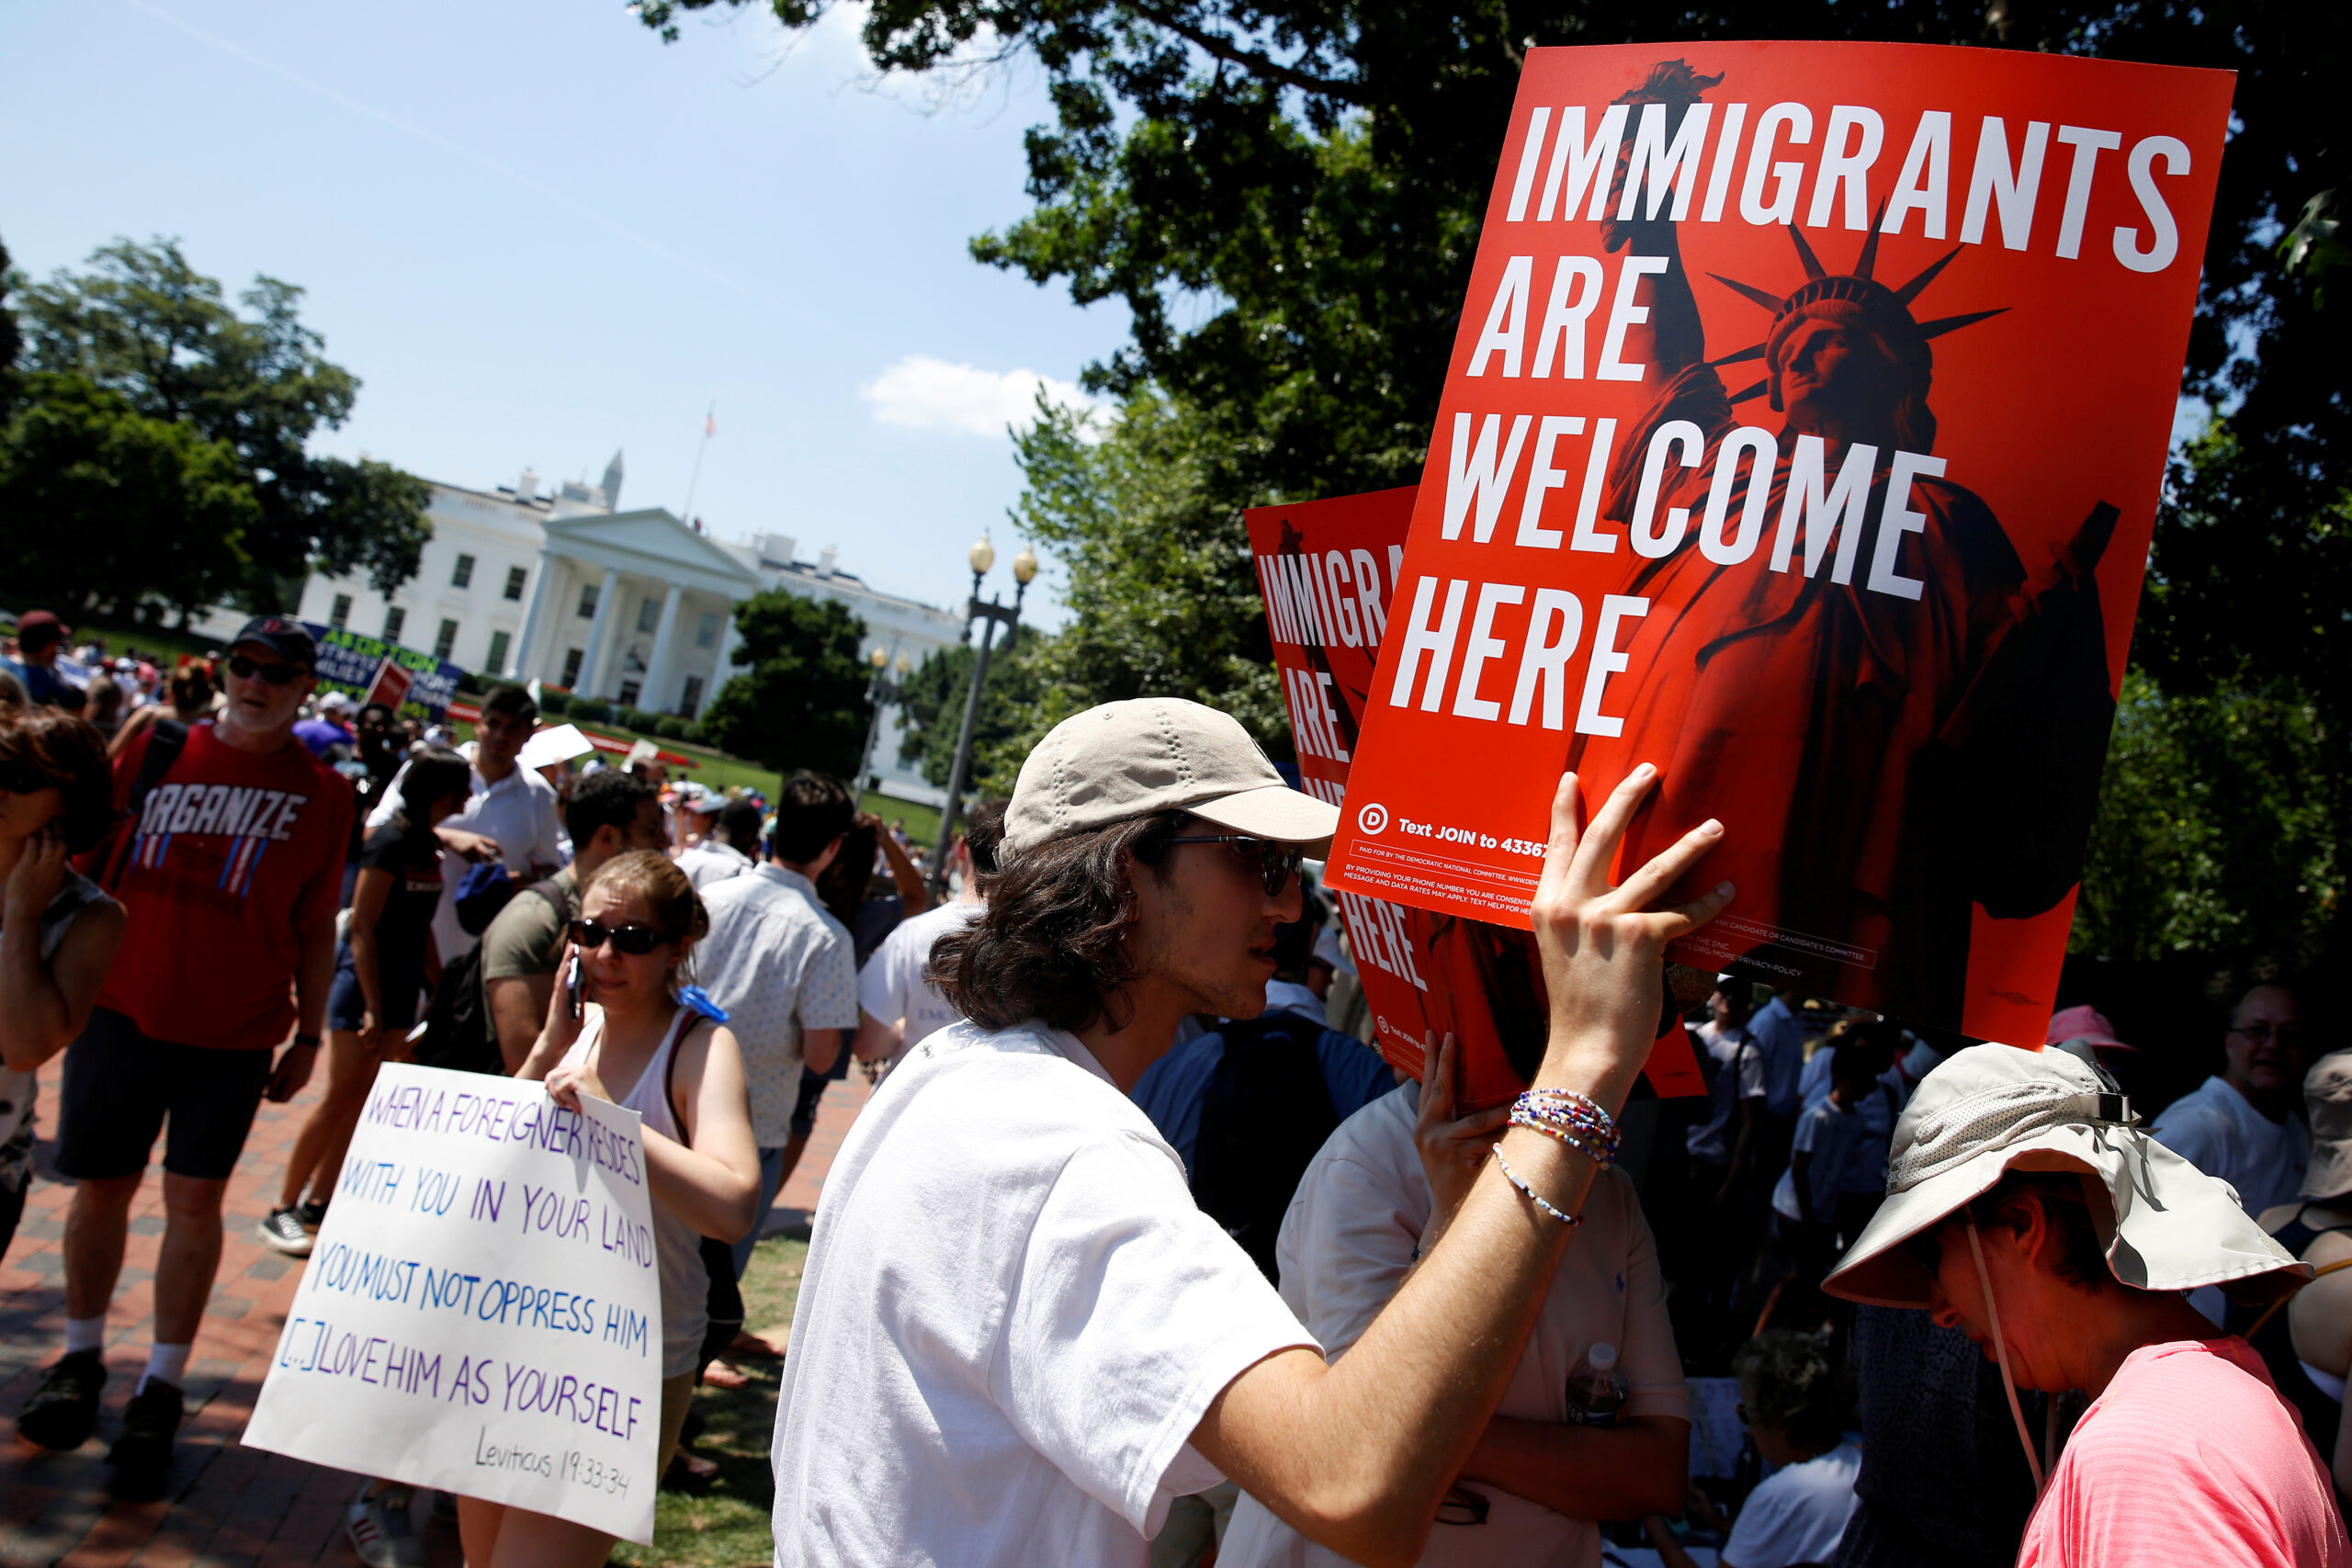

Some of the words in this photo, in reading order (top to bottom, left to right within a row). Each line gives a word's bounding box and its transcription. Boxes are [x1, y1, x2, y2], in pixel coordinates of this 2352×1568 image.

[1504, 101, 2191, 274] IMMIGRANTS
[1466, 254, 1669, 383] ARE
[1441, 411, 1948, 602] WELCOME
[322, 629, 439, 674] ABORTION
[1389, 575, 1651, 739] HERE
[1285, 667, 1351, 764] ARE
[1360, 846, 1373, 854] PAID
[1406, 855, 1443, 868] DEMOCRATIC
[1443, 863, 1472, 874] NATIONAL
[1398, 818, 1432, 837] Text
[1435, 826, 1476, 845] JOIN
[1480, 834, 1498, 849] to
[1344, 872, 1375, 884] MESSAGE
[1375, 878, 1390, 886] AND
[1391, 882, 1408, 890] DATA
[1409, 886, 1430, 895] RATES
[1431, 890, 1446, 898] MAY
[1447, 893, 1468, 903] APPLY.
[1470, 897, 1487, 906] TEXT
[1487, 901, 1505, 909] HELP
[1505, 905, 1520, 913] FOR
[1356, 866, 1392, 879] PROVIDING
[1394, 874, 1411, 883] YOUR
[1412, 878, 1435, 888] PHONE
[1436, 882, 1464, 893] NUMBER
[1465, 888, 1480, 897] YOU
[1481, 892, 1495, 900] ARE
[1496, 895, 1532, 906] CONSENTIN
[1729, 921, 1768, 938] CANDIDATE
[1768, 931, 1780, 940] OR
[1340, 891, 1429, 992] HERE
[368, 1083, 432, 1131] WHEN
[424, 1090, 445, 1133] A
[445, 1093, 583, 1159] FOREIGNER
[342, 1155, 405, 1205] WITH
[410, 1167, 461, 1216] YOU
[470, 1178, 506, 1223] IN
[522, 1183, 591, 1244] YOUR
[603, 1204, 652, 1268] LAND
[311, 1242, 354, 1292] YOU
[352, 1251, 421, 1303] MUST
[419, 1268, 481, 1315] NOT
[478, 1279, 596, 1335] OPPRESS
[603, 1303, 648, 1359] HIM
[318, 1325, 388, 1384] LOVE
[383, 1342, 441, 1399] HIM
[447, 1355, 494, 1406] AS
[503, 1361, 642, 1441] YOURSELF
[475, 1425, 552, 1478] Leviticus
[560, 1450, 631, 1500] 19:33-34
